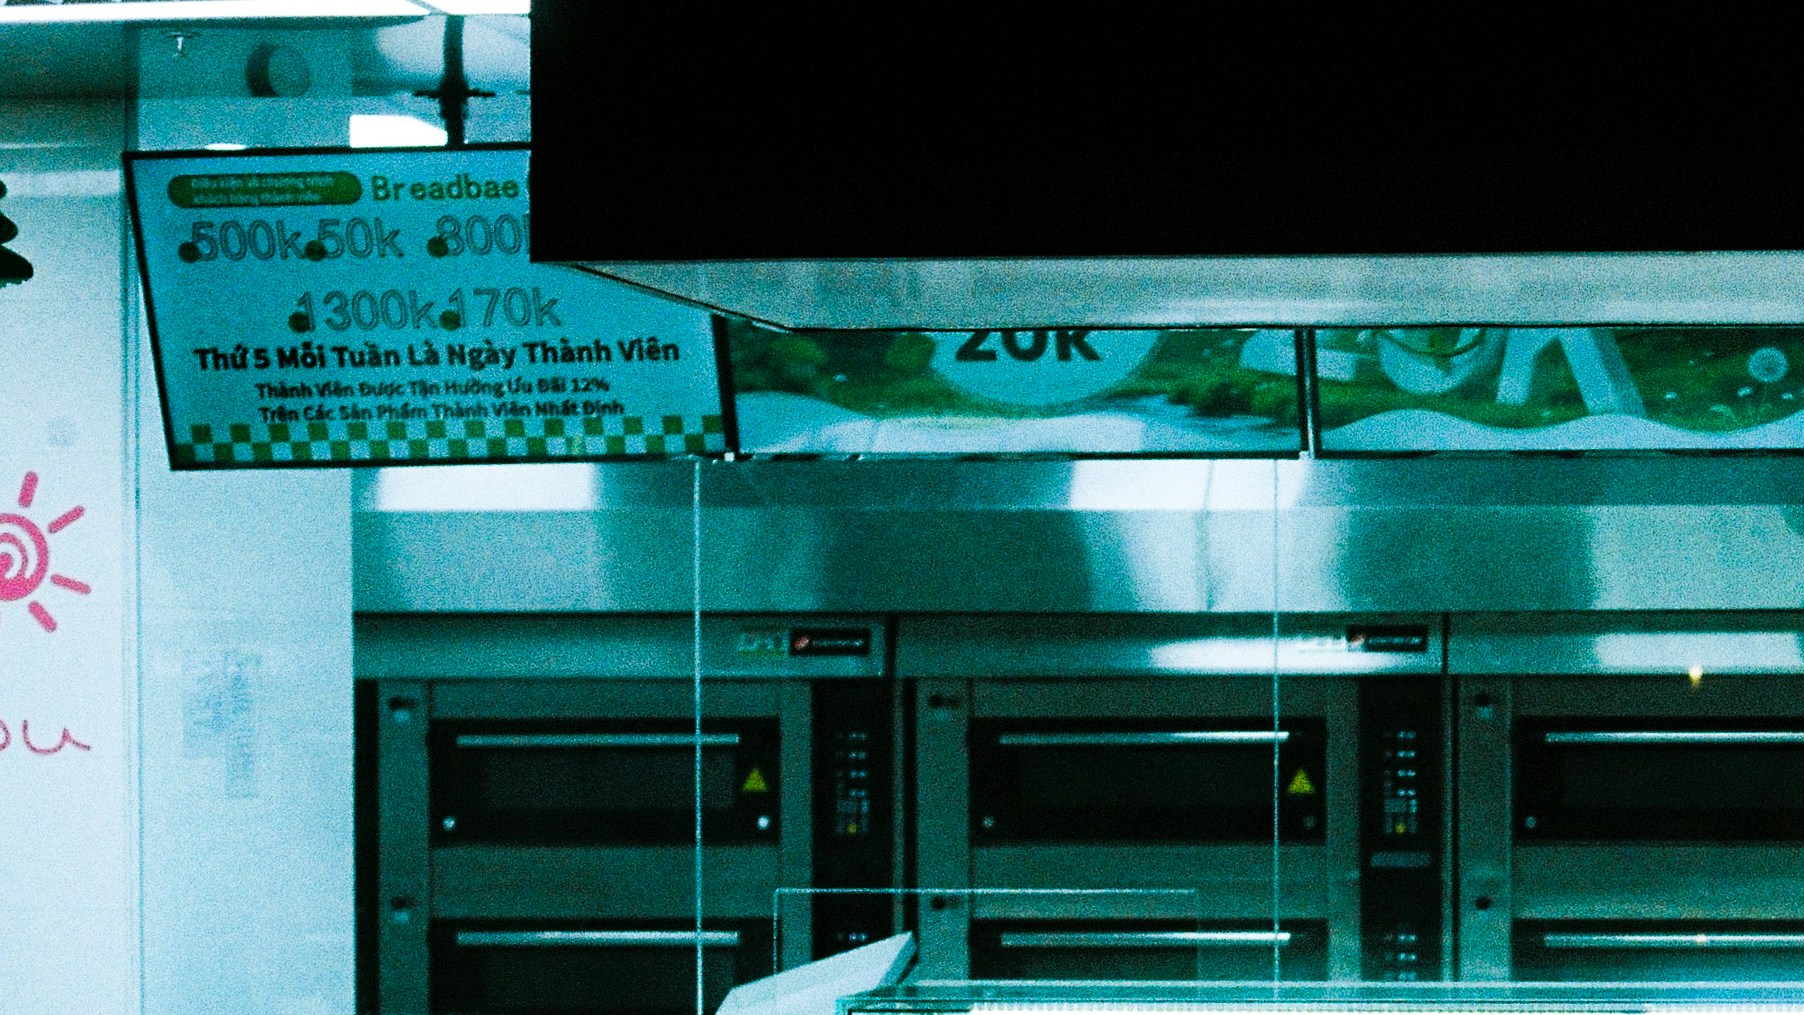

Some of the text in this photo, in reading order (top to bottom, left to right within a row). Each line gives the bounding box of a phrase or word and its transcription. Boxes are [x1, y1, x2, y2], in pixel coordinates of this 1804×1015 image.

[371, 173, 519, 201] Breadbae
[191, 213, 530, 262] 500k 50k 800
[298, 286, 561, 331] 1300k 170k
[195, 342, 249, 370] Thứ
[253, 347, 270, 369] 5
[407, 339, 440, 366] Là
[447, 338, 516, 371] Ngày
[521, 336, 612, 363] Thành
[616, 335, 680, 362] Viên
[255, 381, 313, 398] Thành
[258, 404, 299, 422] Trên
[302, 403, 336, 420] Các
